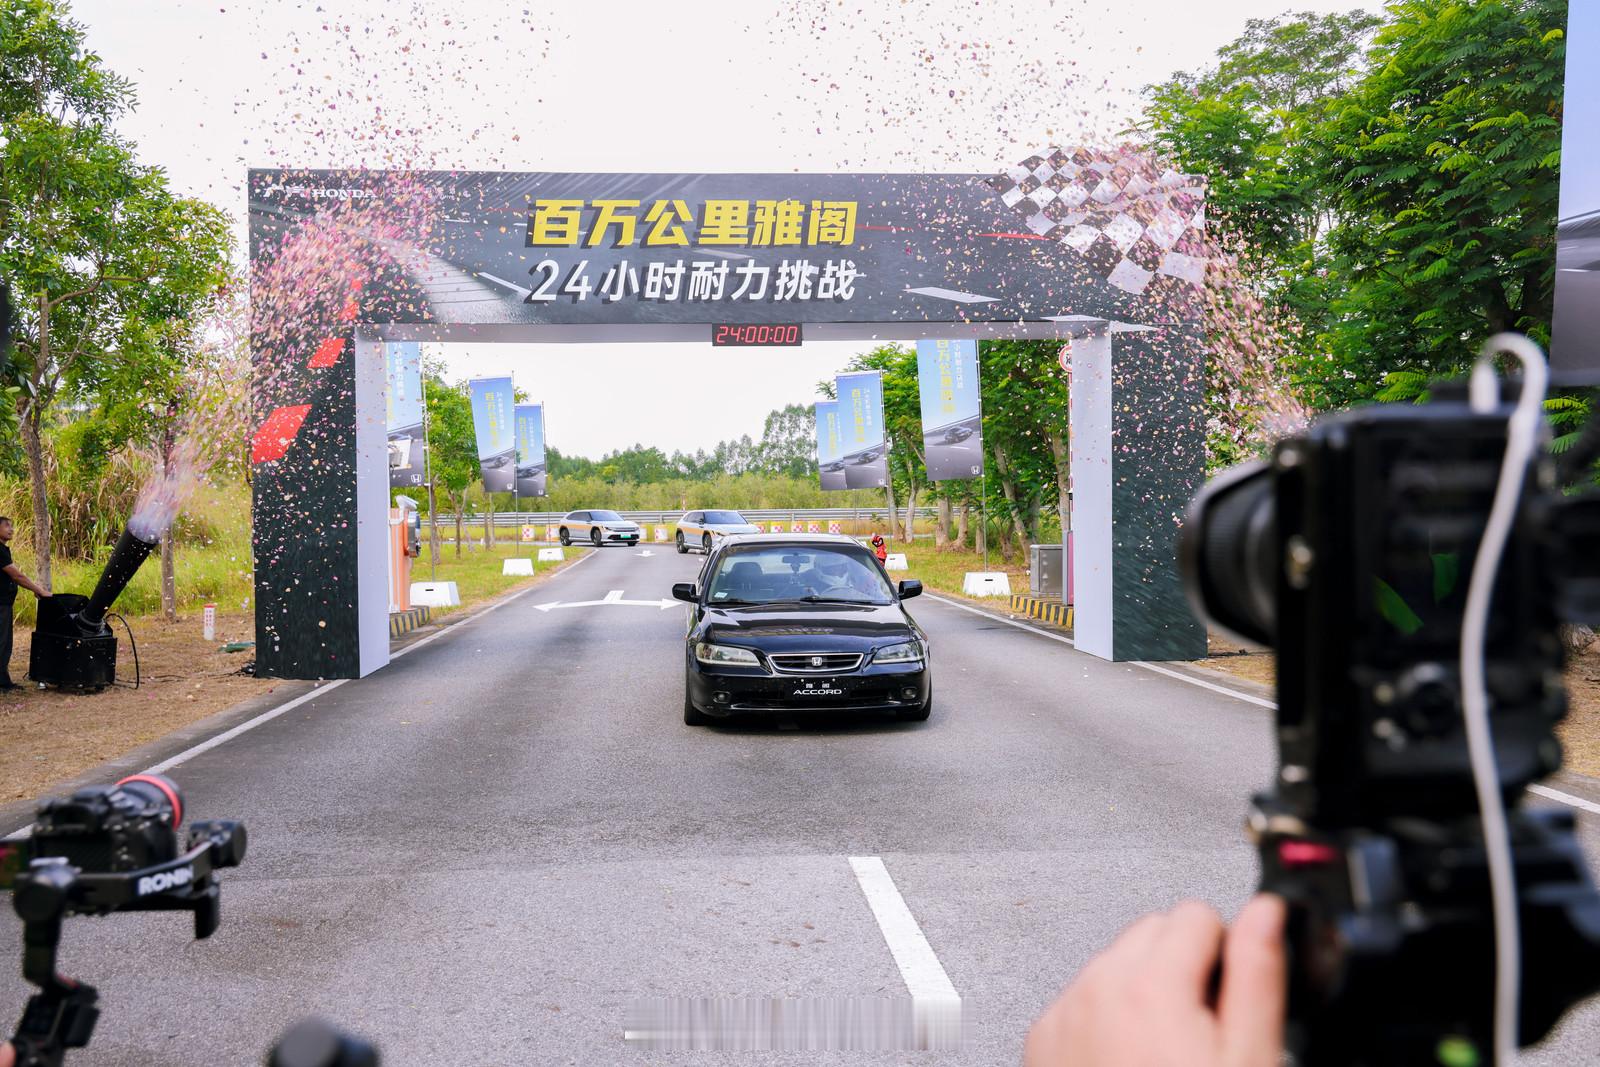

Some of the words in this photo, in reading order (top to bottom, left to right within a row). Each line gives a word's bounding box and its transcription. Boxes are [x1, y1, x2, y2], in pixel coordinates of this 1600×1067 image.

[312, 188, 377, 199] HONDA
[531, 199, 858, 246] 百万公里雅阁
[531, 259, 858, 301] 24小时耐力挑战
[716, 325, 798, 343] 24:00:00
[138, 865, 194, 896] RONIN
